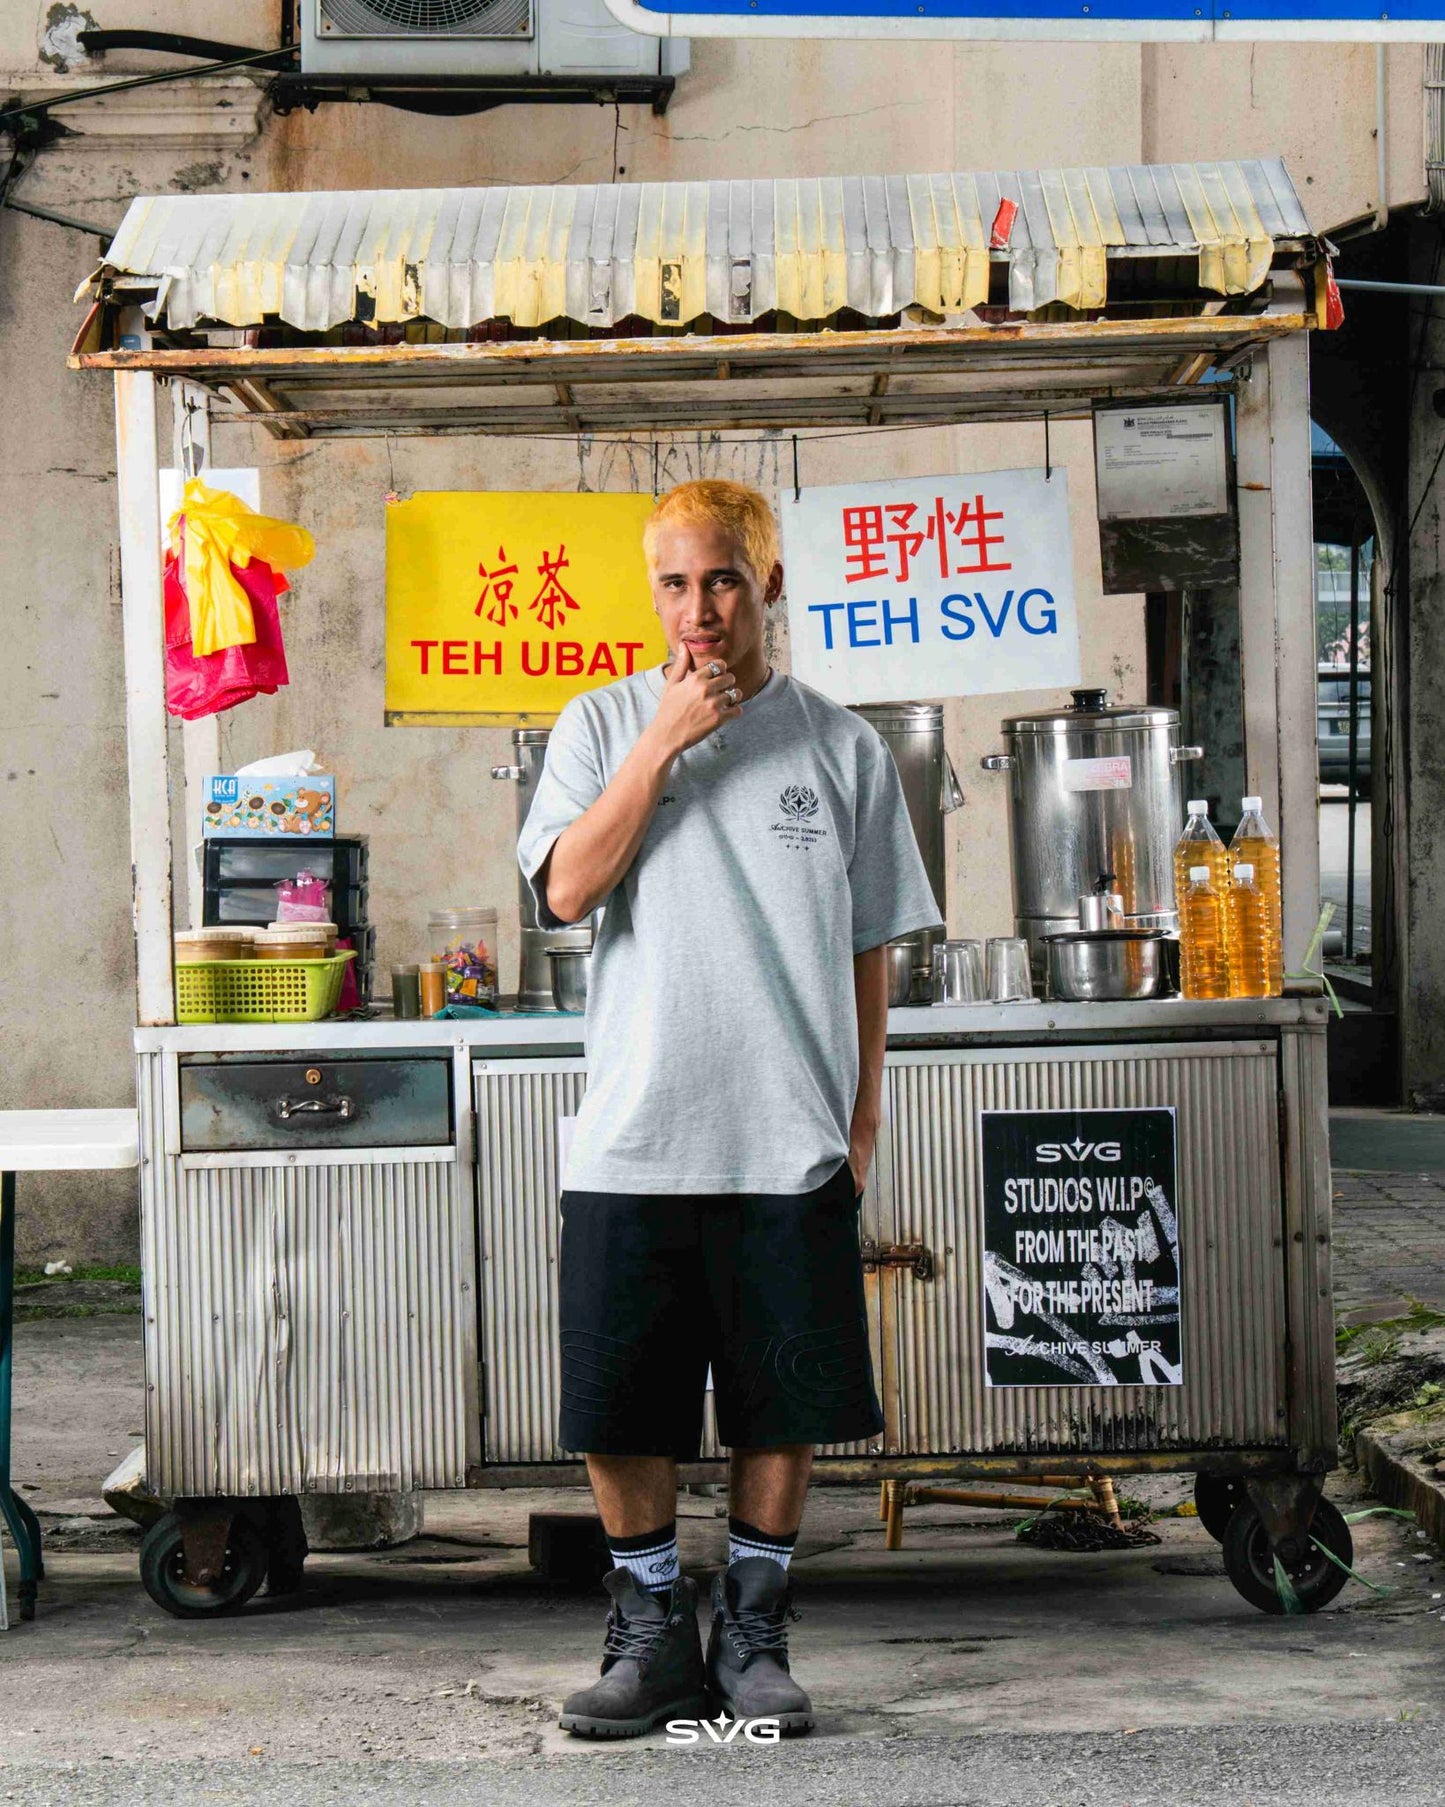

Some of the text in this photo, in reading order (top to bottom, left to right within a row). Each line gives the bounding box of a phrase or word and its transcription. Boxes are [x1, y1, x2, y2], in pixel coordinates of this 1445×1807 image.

[843, 495, 1012, 584] 野性
[474, 543, 581, 631] 凉茶
[808, 588, 1058, 650] TEH SVG
[410, 640, 644, 677] TEH UBAT
[801, 827, 827, 836] SUMMER
[1035, 1136, 1122, 1163] SVG
[1004, 1177, 1093, 1214] STUDIOS
[1015, 1229, 1146, 1263] FROM THE PAST
[1045, 1280, 1079, 1314] THE
[1080, 1279, 1154, 1314] PRESENT
